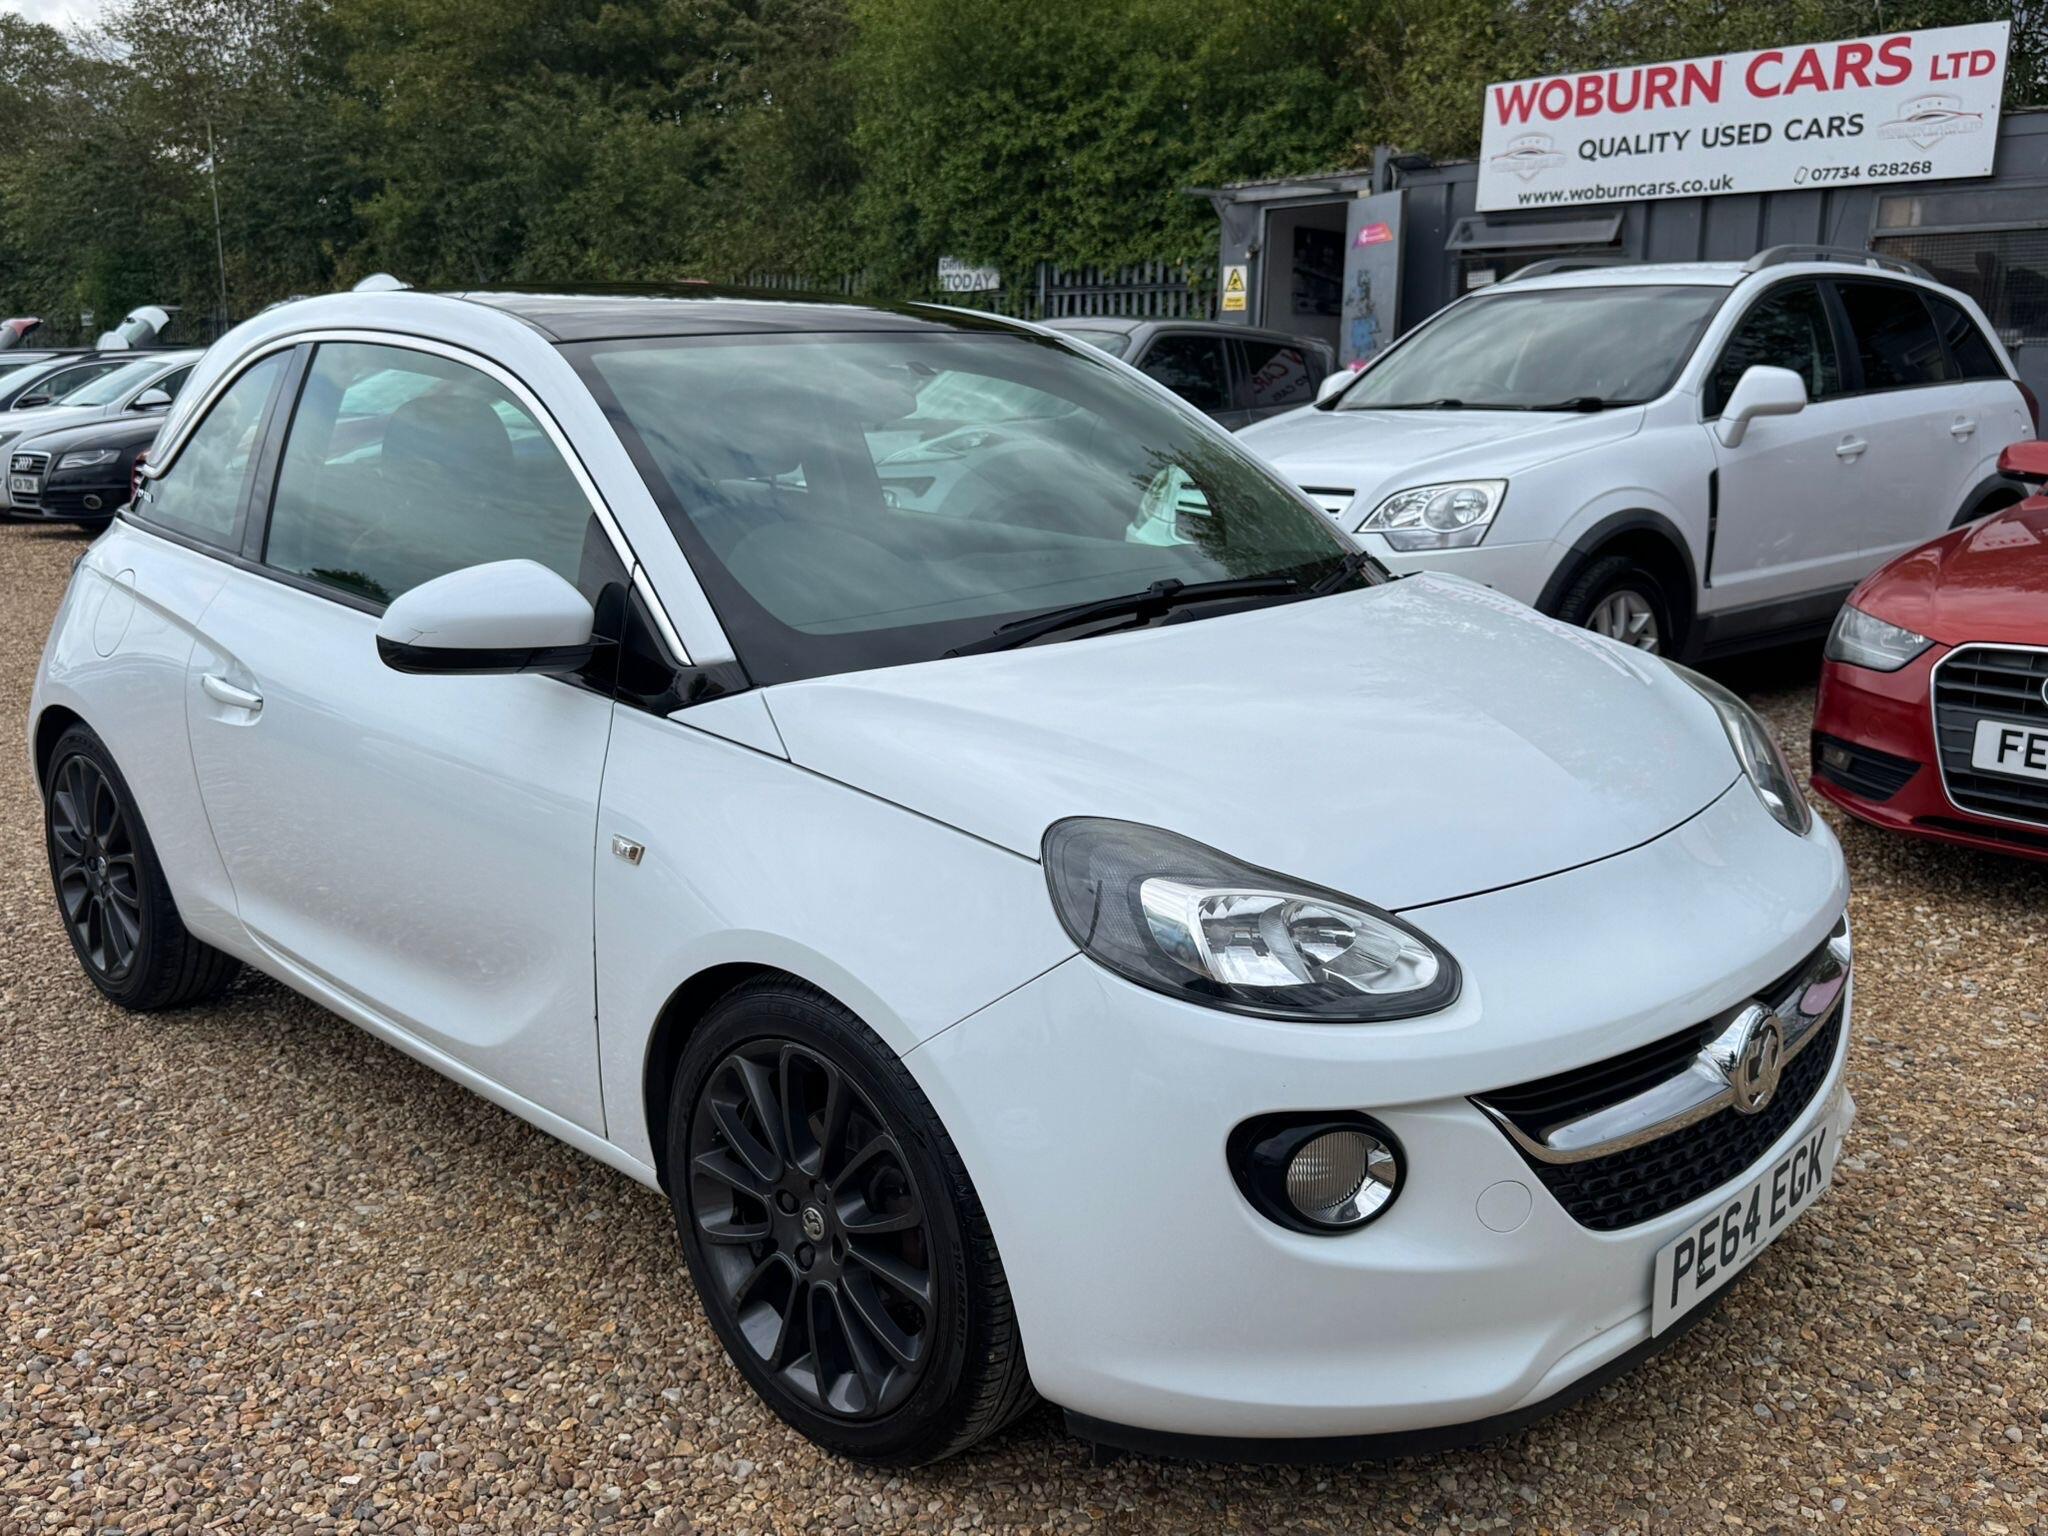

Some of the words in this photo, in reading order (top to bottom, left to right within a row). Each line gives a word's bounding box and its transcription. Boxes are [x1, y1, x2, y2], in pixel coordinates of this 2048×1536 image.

[1495, 60, 1723, 125] WOBURN
[1745, 36, 1912, 98] CARS
[1930, 50, 1996, 82] LTD
[1578, 129, 1692, 162] QUALITY
[1701, 122, 1772, 149] USED
[1784, 113, 1864, 142] CARS
[1518, 173, 1734, 205] www.woburncars.co.uk
[1810, 165, 1861, 181] 07734
[1867, 160, 1933, 178] 628268
[945, 272, 993, 291] TODAY
[1670, 1183, 1761, 1310] PE64
[1768, 1126, 1827, 1229] EGK
